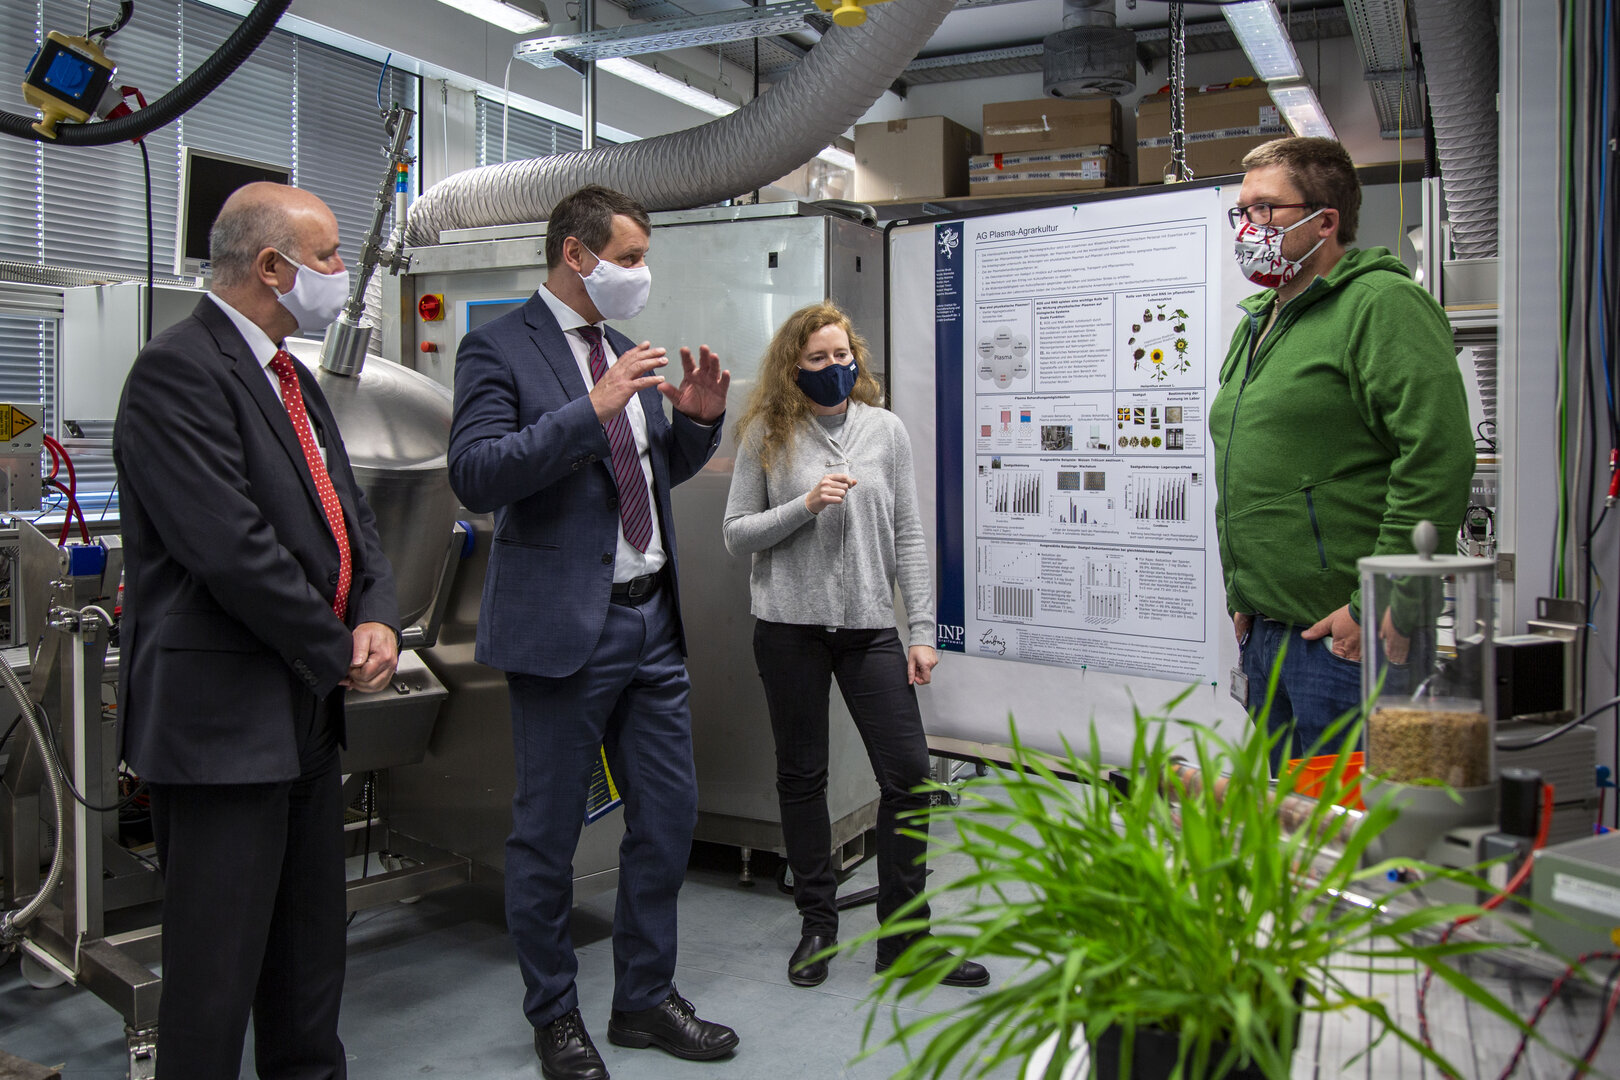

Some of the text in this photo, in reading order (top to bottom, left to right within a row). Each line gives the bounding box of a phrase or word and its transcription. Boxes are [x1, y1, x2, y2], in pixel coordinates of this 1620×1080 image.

[976, 225, 1059, 240] AG Plasma-Agrarkultur
[938, 624, 964, 640] INP
